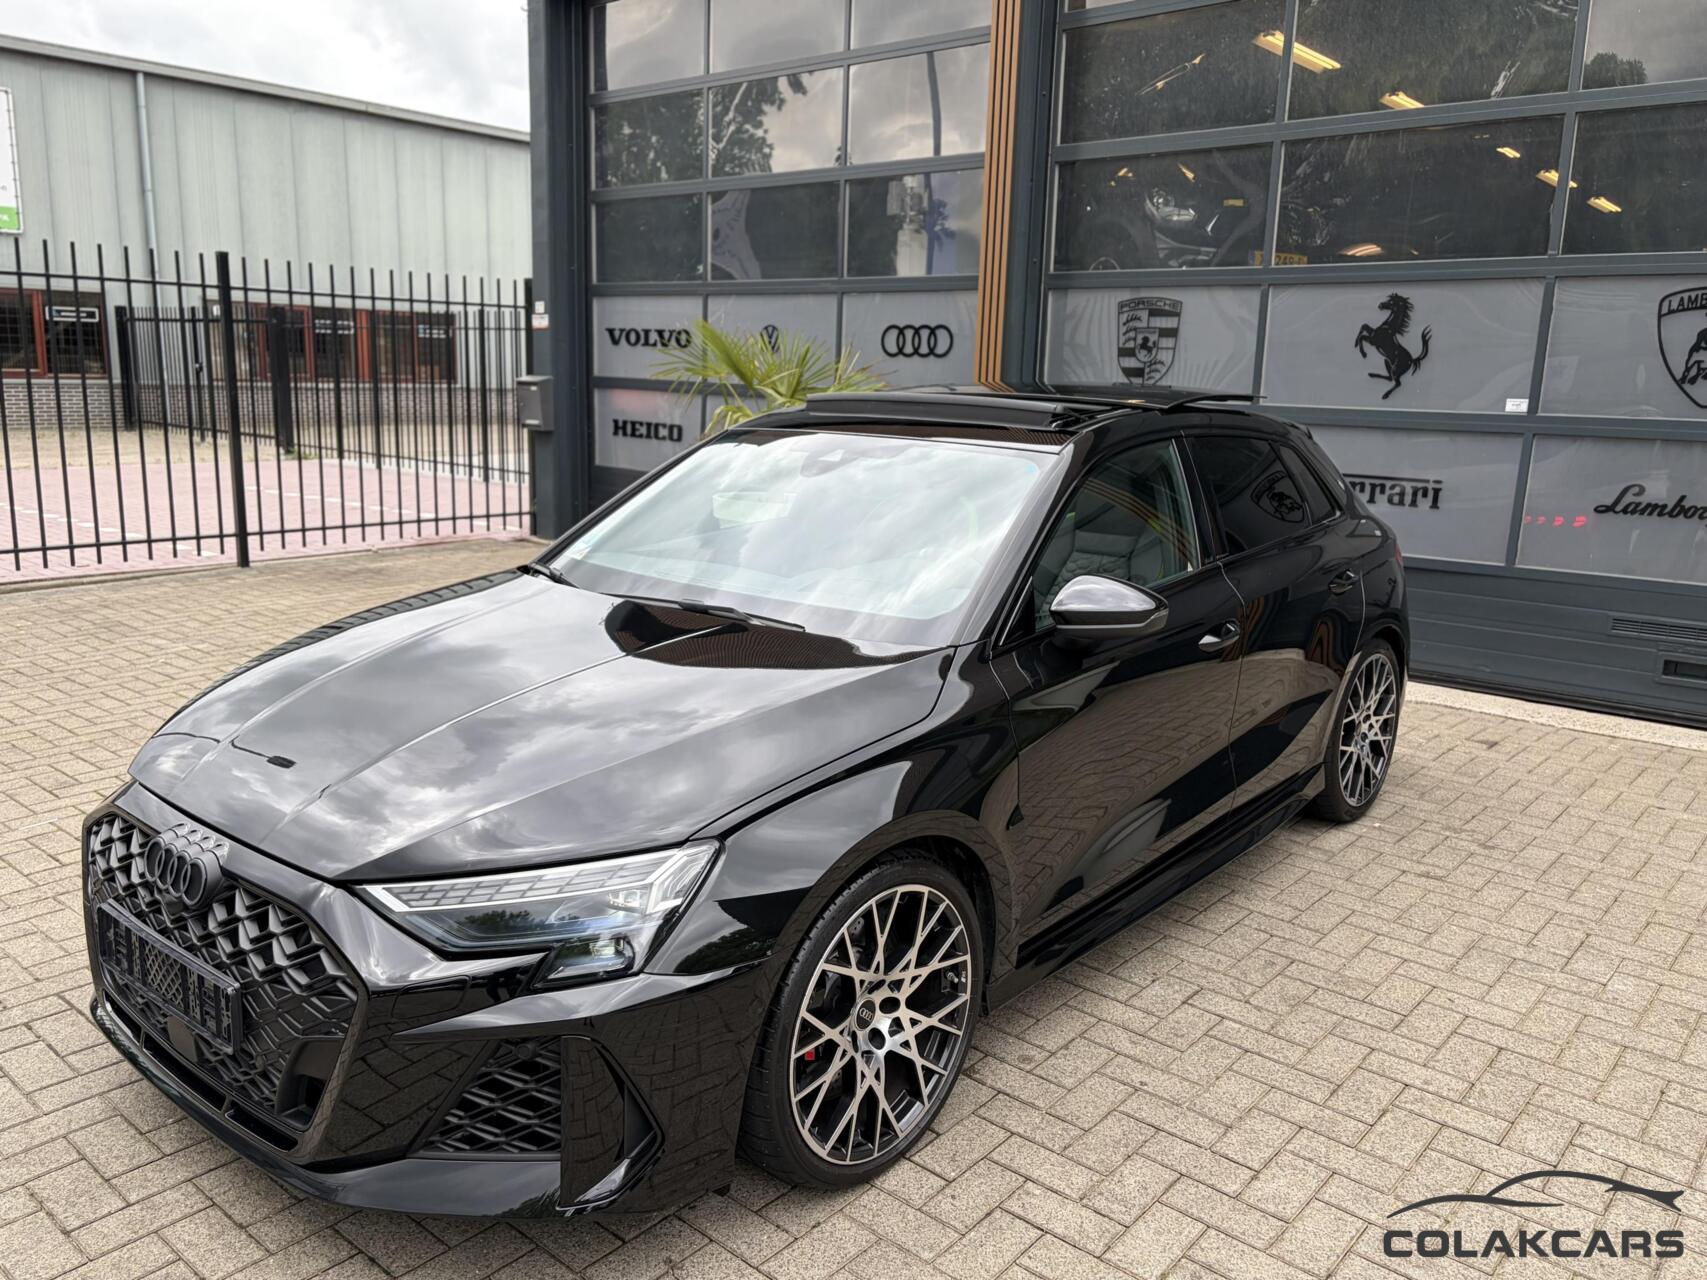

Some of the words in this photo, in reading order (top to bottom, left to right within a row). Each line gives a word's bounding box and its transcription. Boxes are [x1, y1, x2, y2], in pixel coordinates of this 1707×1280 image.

[1119, 298, 1181, 311] PORSCHE
[605, 328, 692, 348] VOLVO
[612, 418, 683, 442] HEICO
[1343, 473, 1443, 510] rrari
